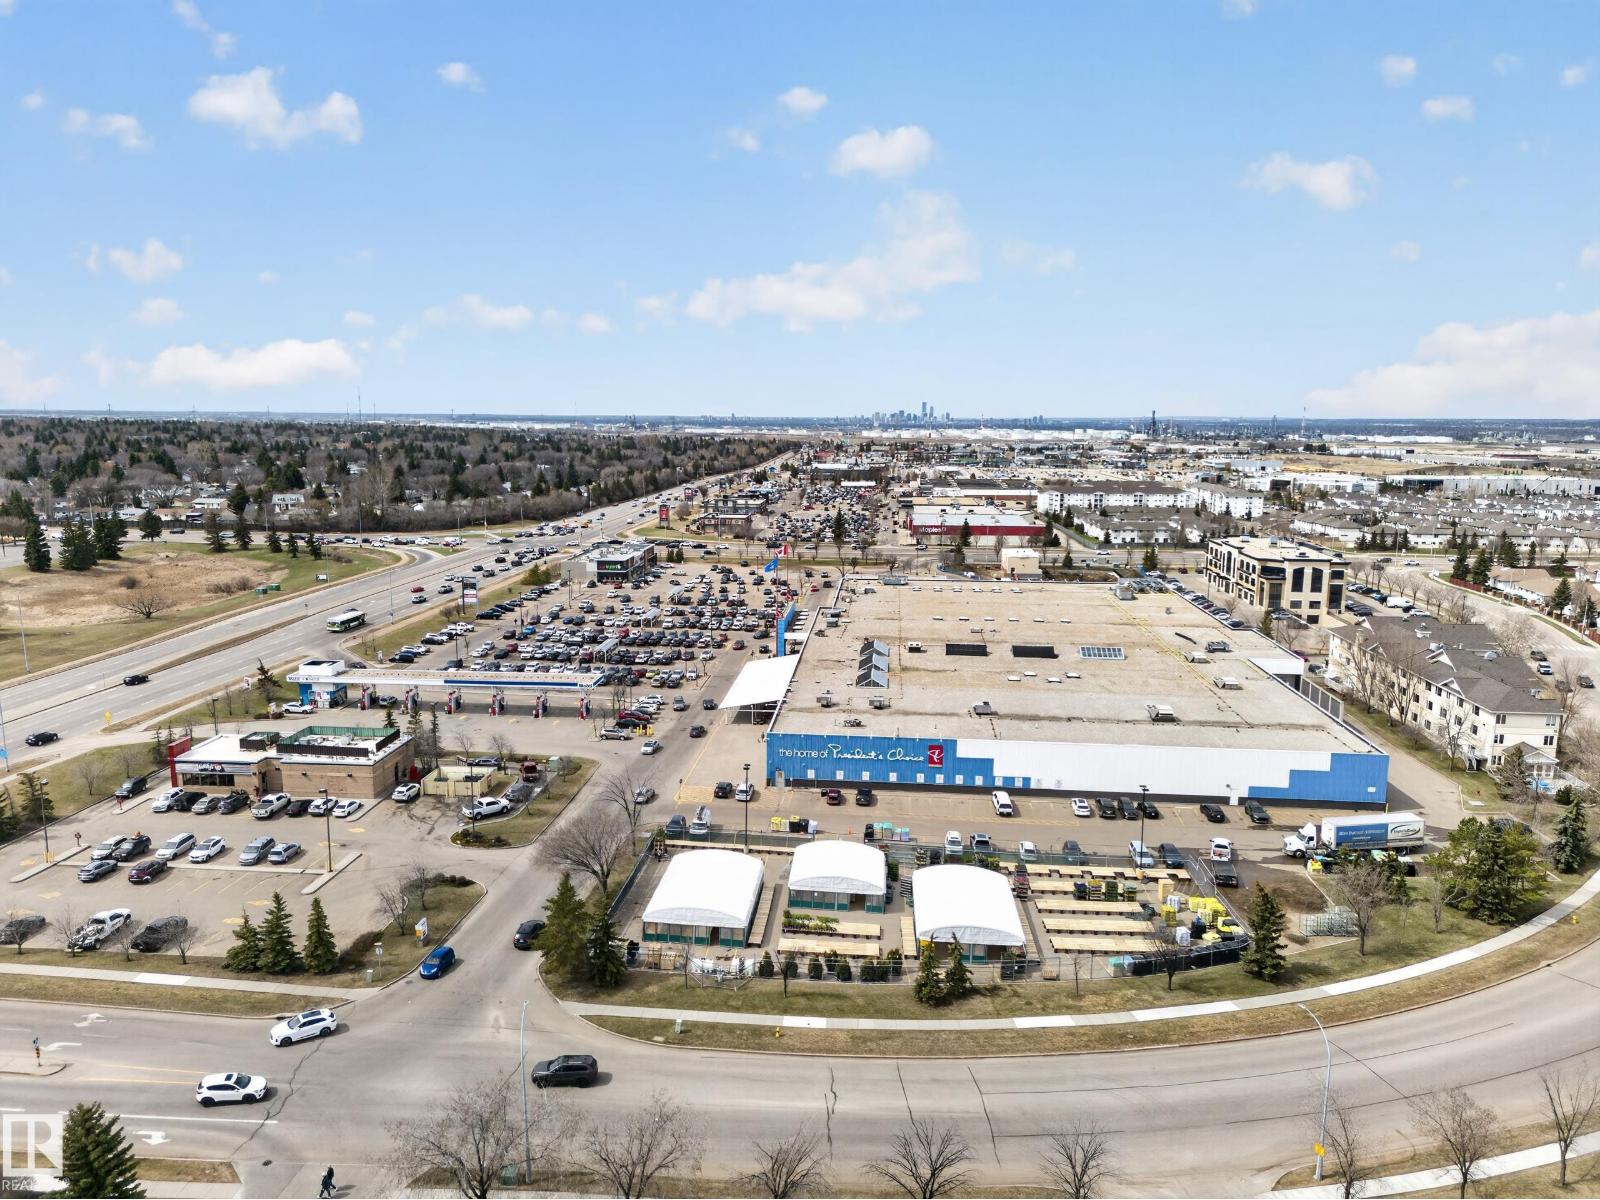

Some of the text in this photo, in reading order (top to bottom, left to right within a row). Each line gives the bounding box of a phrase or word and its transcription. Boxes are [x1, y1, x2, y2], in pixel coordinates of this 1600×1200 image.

[779, 748, 792, 757] the
[793, 748, 818, 758] home
[819, 750, 829, 758] of
[887, 748, 924, 761] Choice
